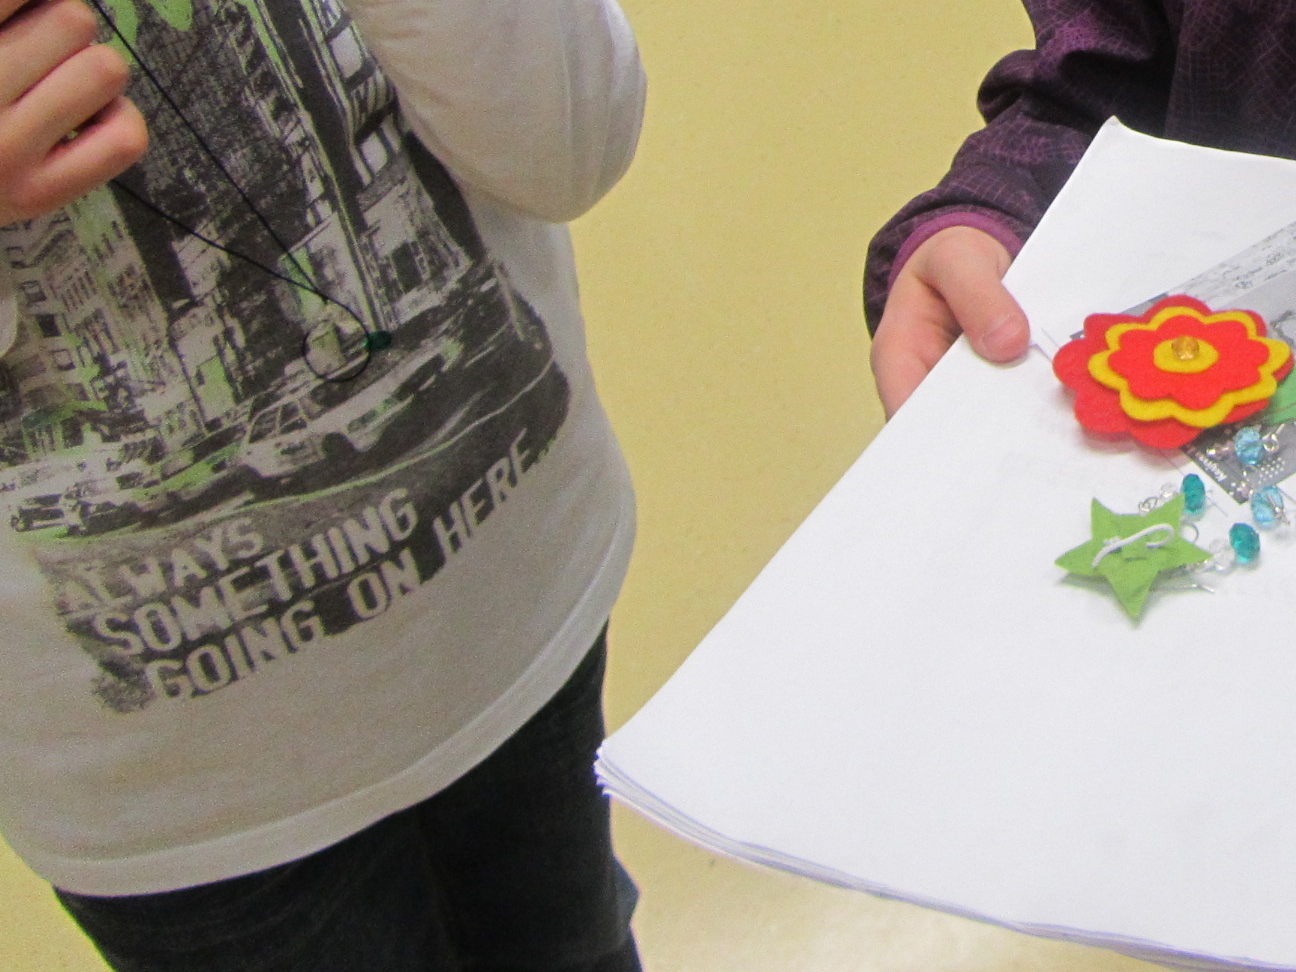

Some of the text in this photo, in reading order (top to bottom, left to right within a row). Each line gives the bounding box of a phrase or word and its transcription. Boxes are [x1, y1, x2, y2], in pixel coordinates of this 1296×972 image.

[92, 487, 419, 656] SOMETHING
[146, 428, 539, 699] GOING ON HERE
